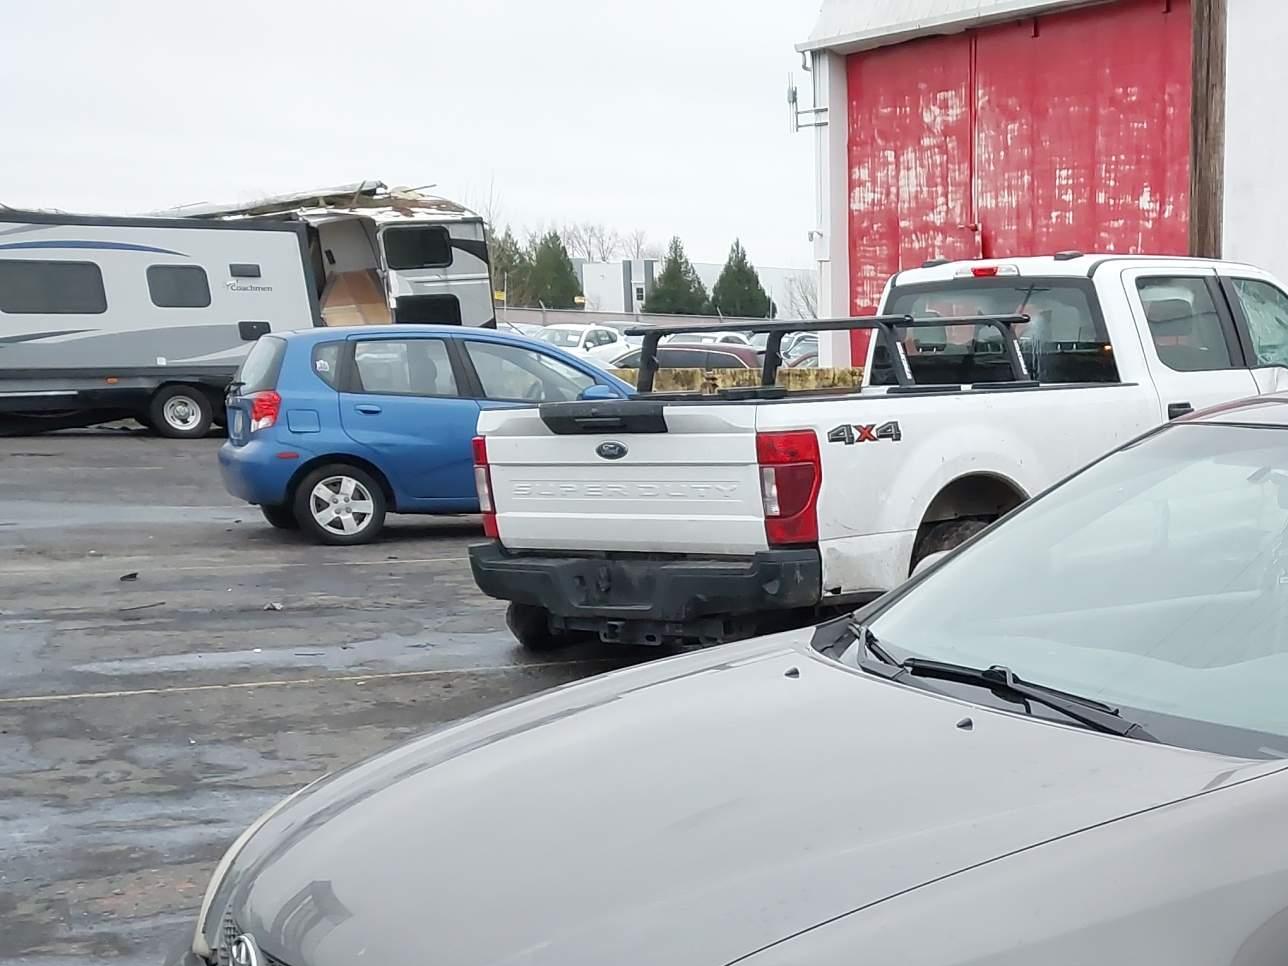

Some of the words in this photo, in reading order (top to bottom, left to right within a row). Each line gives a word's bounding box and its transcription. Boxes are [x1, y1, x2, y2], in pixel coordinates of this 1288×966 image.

[600, 443, 623, 456] Ford
[512, 482, 627, 498] SUPER
[636, 482, 738, 498] DUTY
